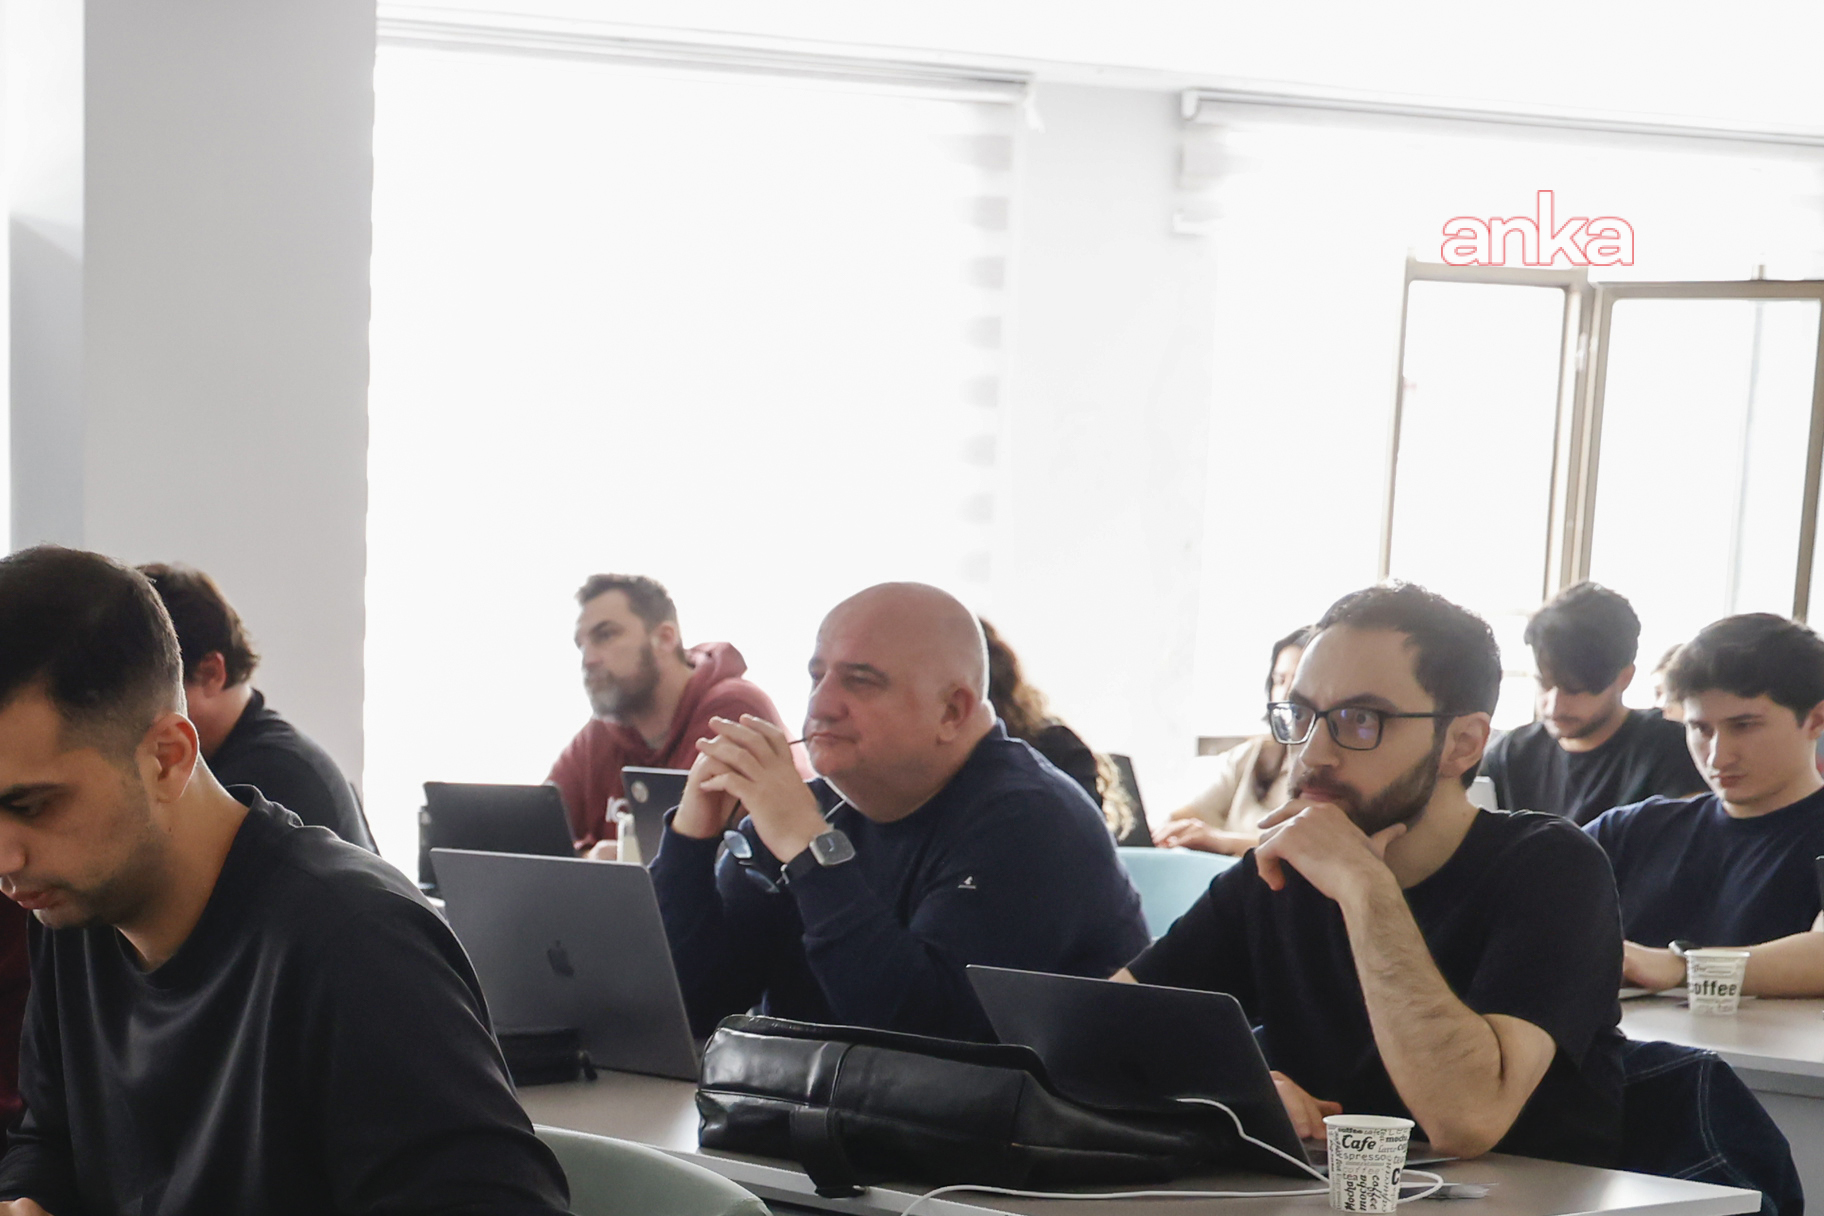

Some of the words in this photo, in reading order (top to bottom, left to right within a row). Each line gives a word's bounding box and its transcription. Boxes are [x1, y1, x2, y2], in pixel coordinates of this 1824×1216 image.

[1342, 1134, 1377, 1152] Cafe
[1344, 1181, 1357, 1211] Mocha
[1356, 1174, 1367, 1211] mocha
